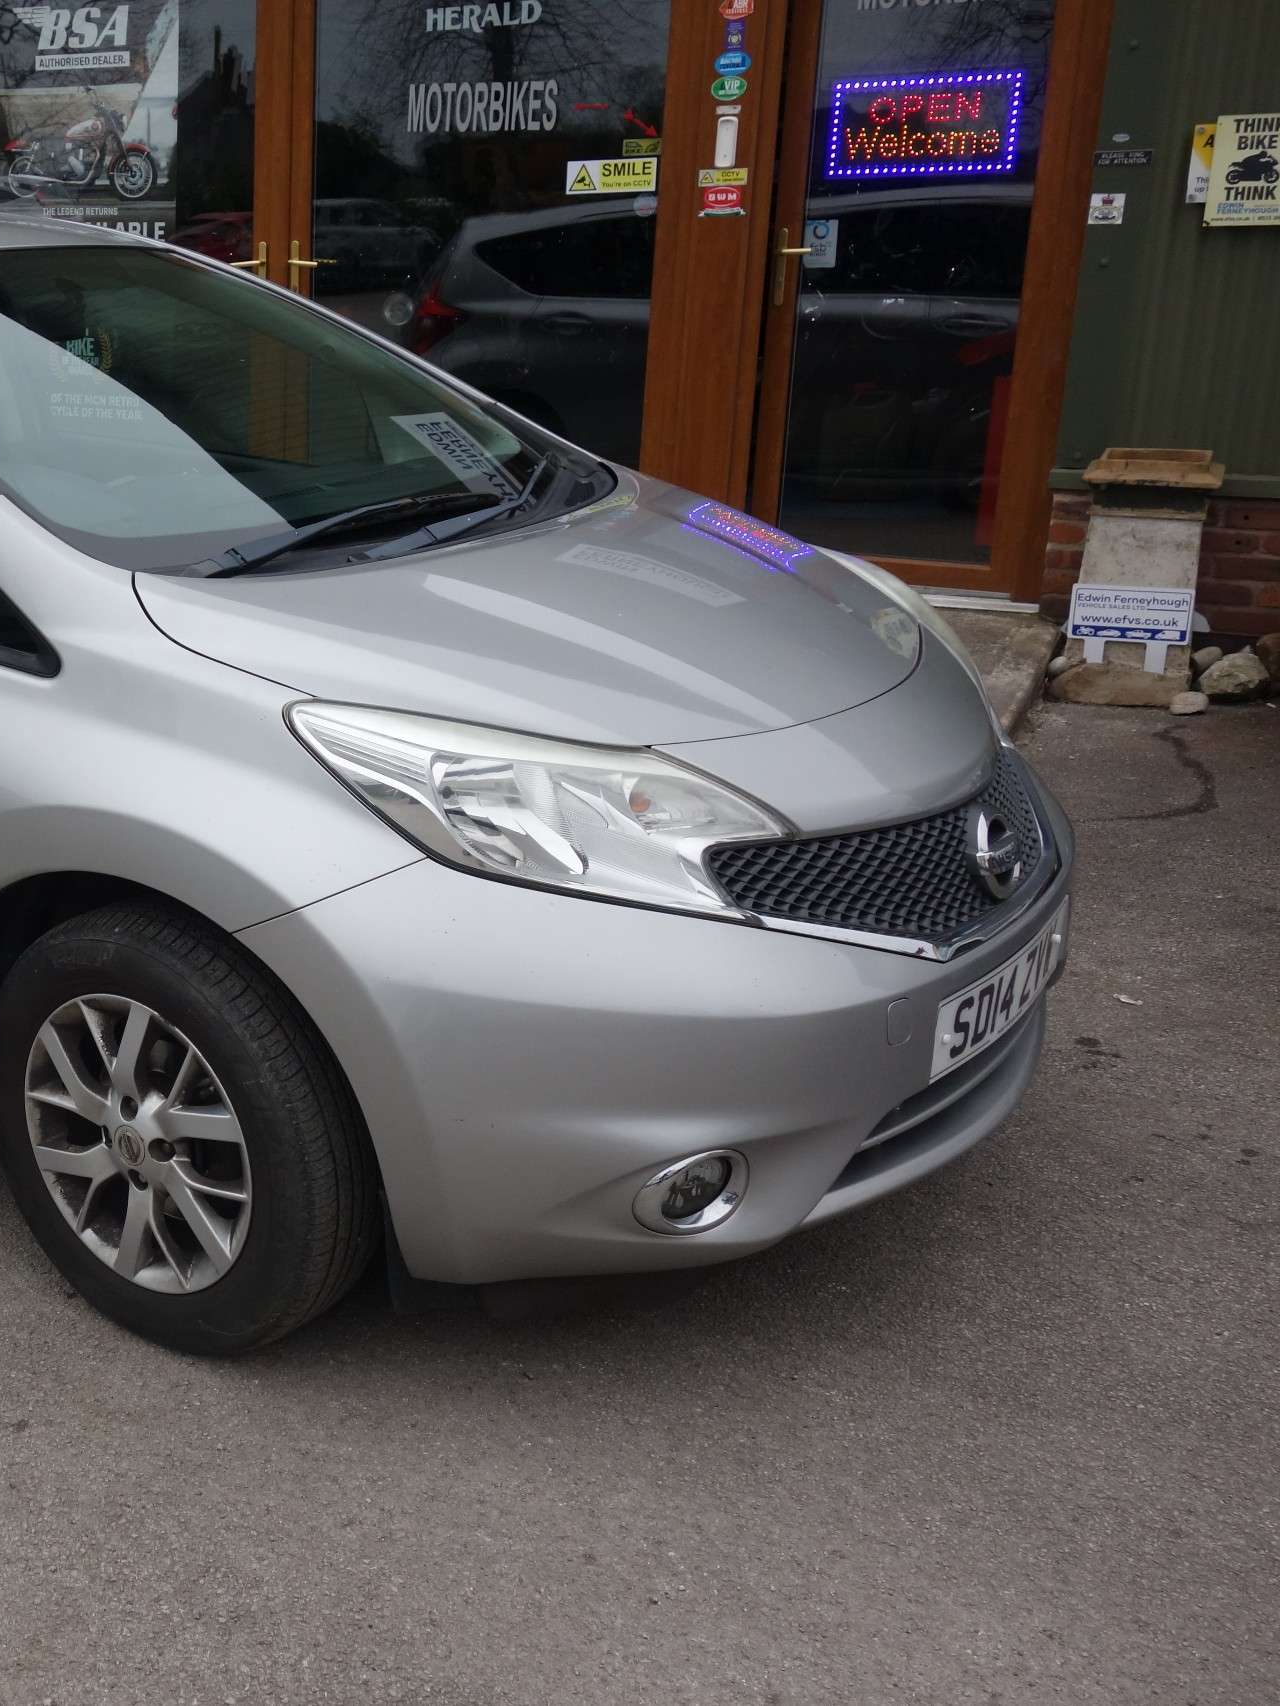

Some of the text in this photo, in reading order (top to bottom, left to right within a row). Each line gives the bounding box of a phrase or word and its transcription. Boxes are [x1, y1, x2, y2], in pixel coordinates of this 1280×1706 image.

[426, 0, 543, 33] HERALD
[37, 5, 129, 50] BSA
[40, 56, 90, 68] AUTHORISED
[408, 78, 559, 133] MOTORBIKES
[869, 91, 982, 124] OPEN
[845, 125, 1001, 160] Welcome
[1237, 134, 1279, 150] BIKE
[602, 161, 653, 177] SMILE
[633, 180, 651, 188] CCTV
[1224, 185, 1278, 201] THINK
[42, 207, 119, 216] THE LEGEND RETURNS
[1077, 593, 1189, 608] Edwin Ferneyhough
[1081, 615, 1179, 627] www.efvs.co.uk
[949, 964, 1018, 1059] SD14
